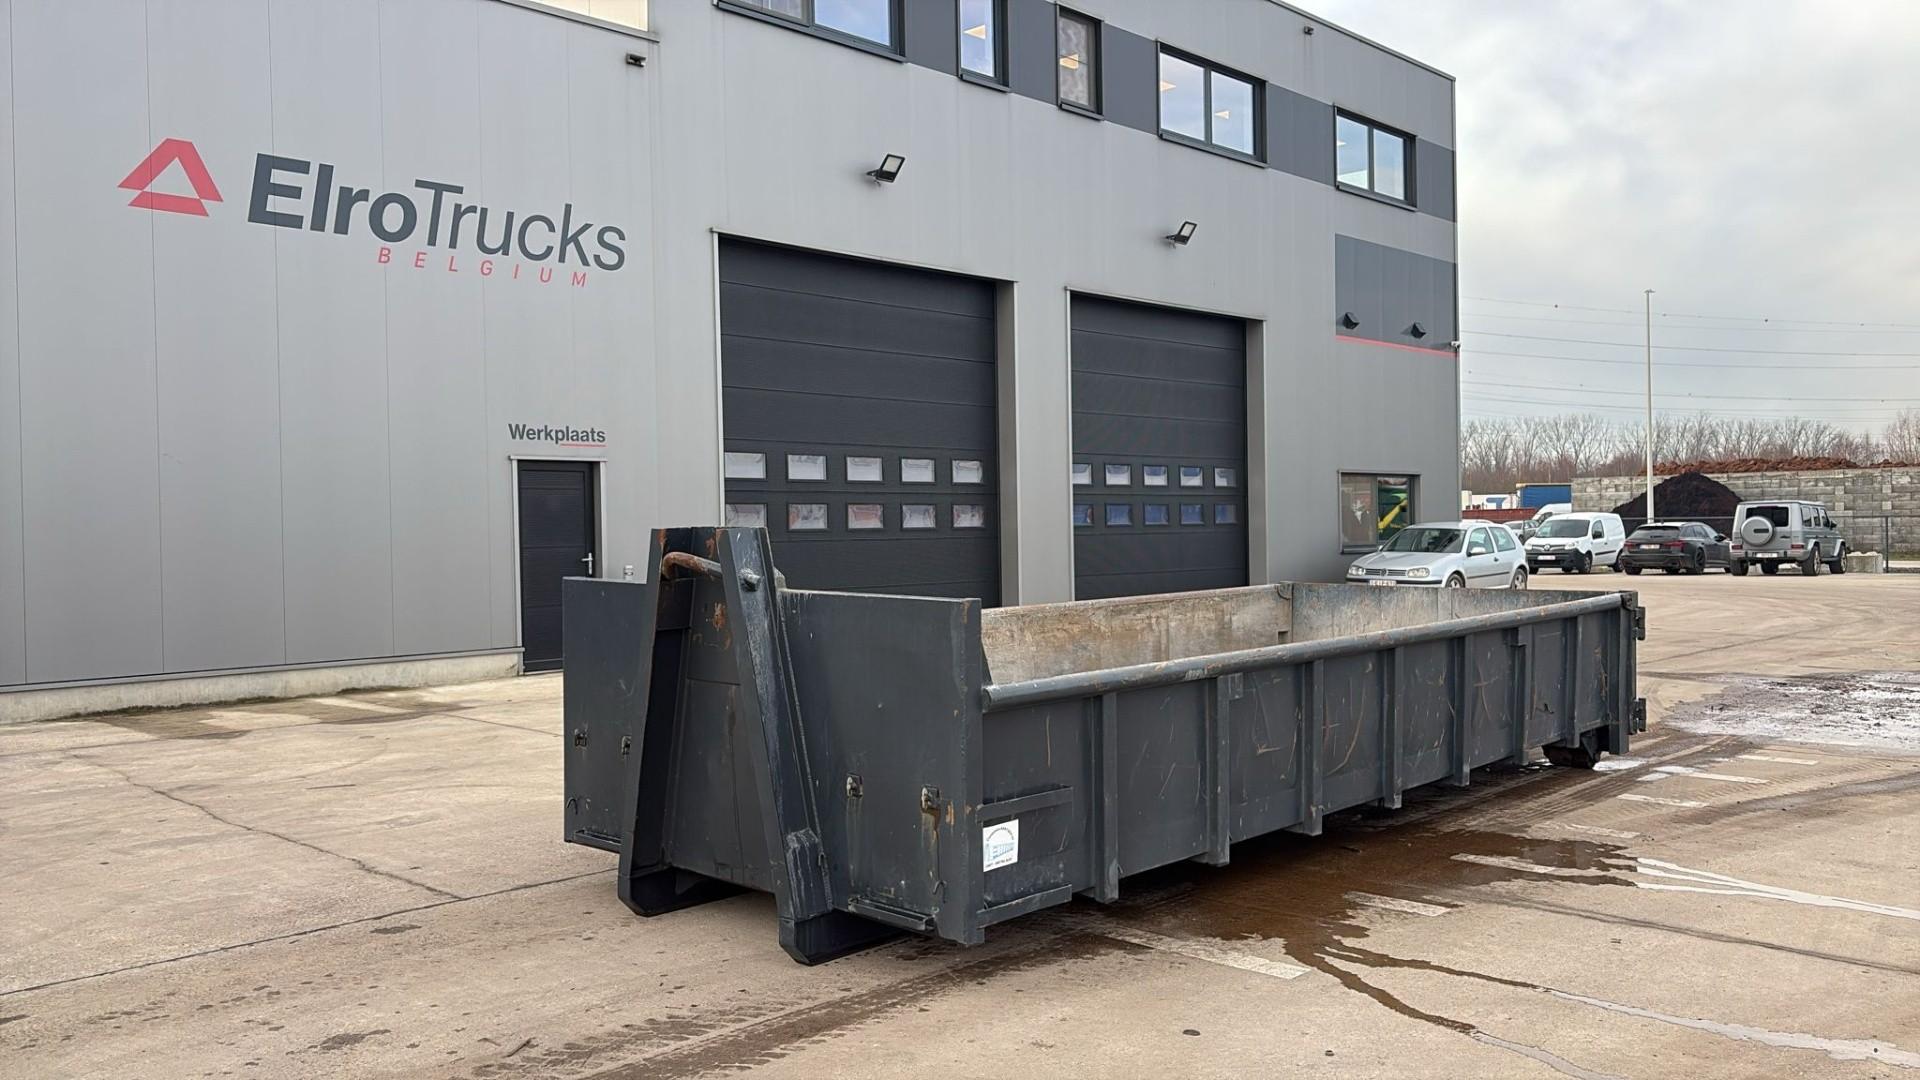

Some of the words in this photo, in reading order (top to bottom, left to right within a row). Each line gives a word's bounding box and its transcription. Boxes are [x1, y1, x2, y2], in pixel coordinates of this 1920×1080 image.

[247, 153, 626, 271] ElroTrucks
[378, 246, 587, 287] BELGIUM
[507, 423, 606, 445] Werkplaats
